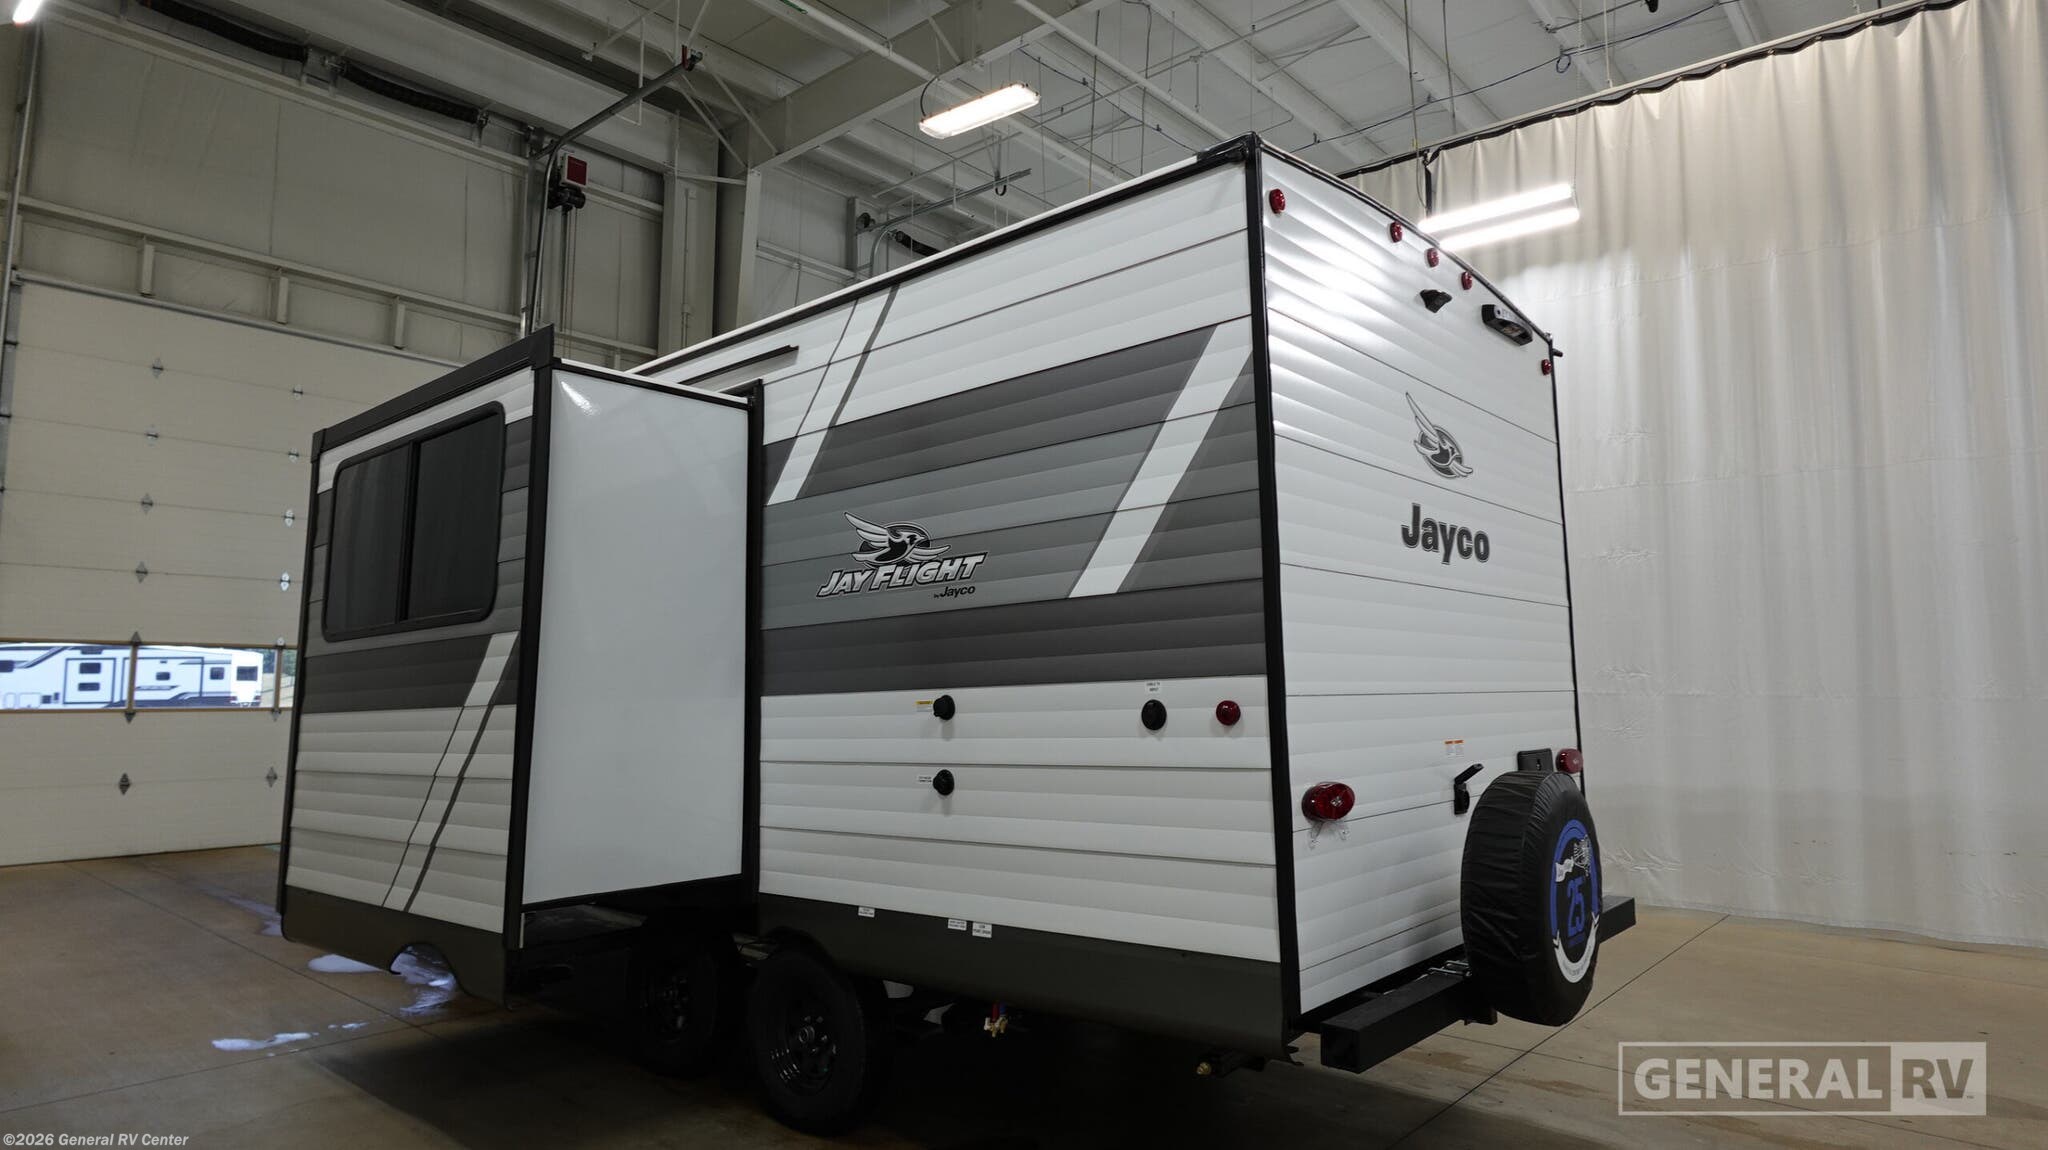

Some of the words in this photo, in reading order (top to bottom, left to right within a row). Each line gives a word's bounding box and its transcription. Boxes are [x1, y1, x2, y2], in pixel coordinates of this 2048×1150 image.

[1401, 503, 1490, 565] Jayco
[817, 569, 873, 597] JAY
[869, 552, 988, 591] FLIGHT
[940, 586, 976, 598] Jayco
[1566, 876, 1585, 938] 25
